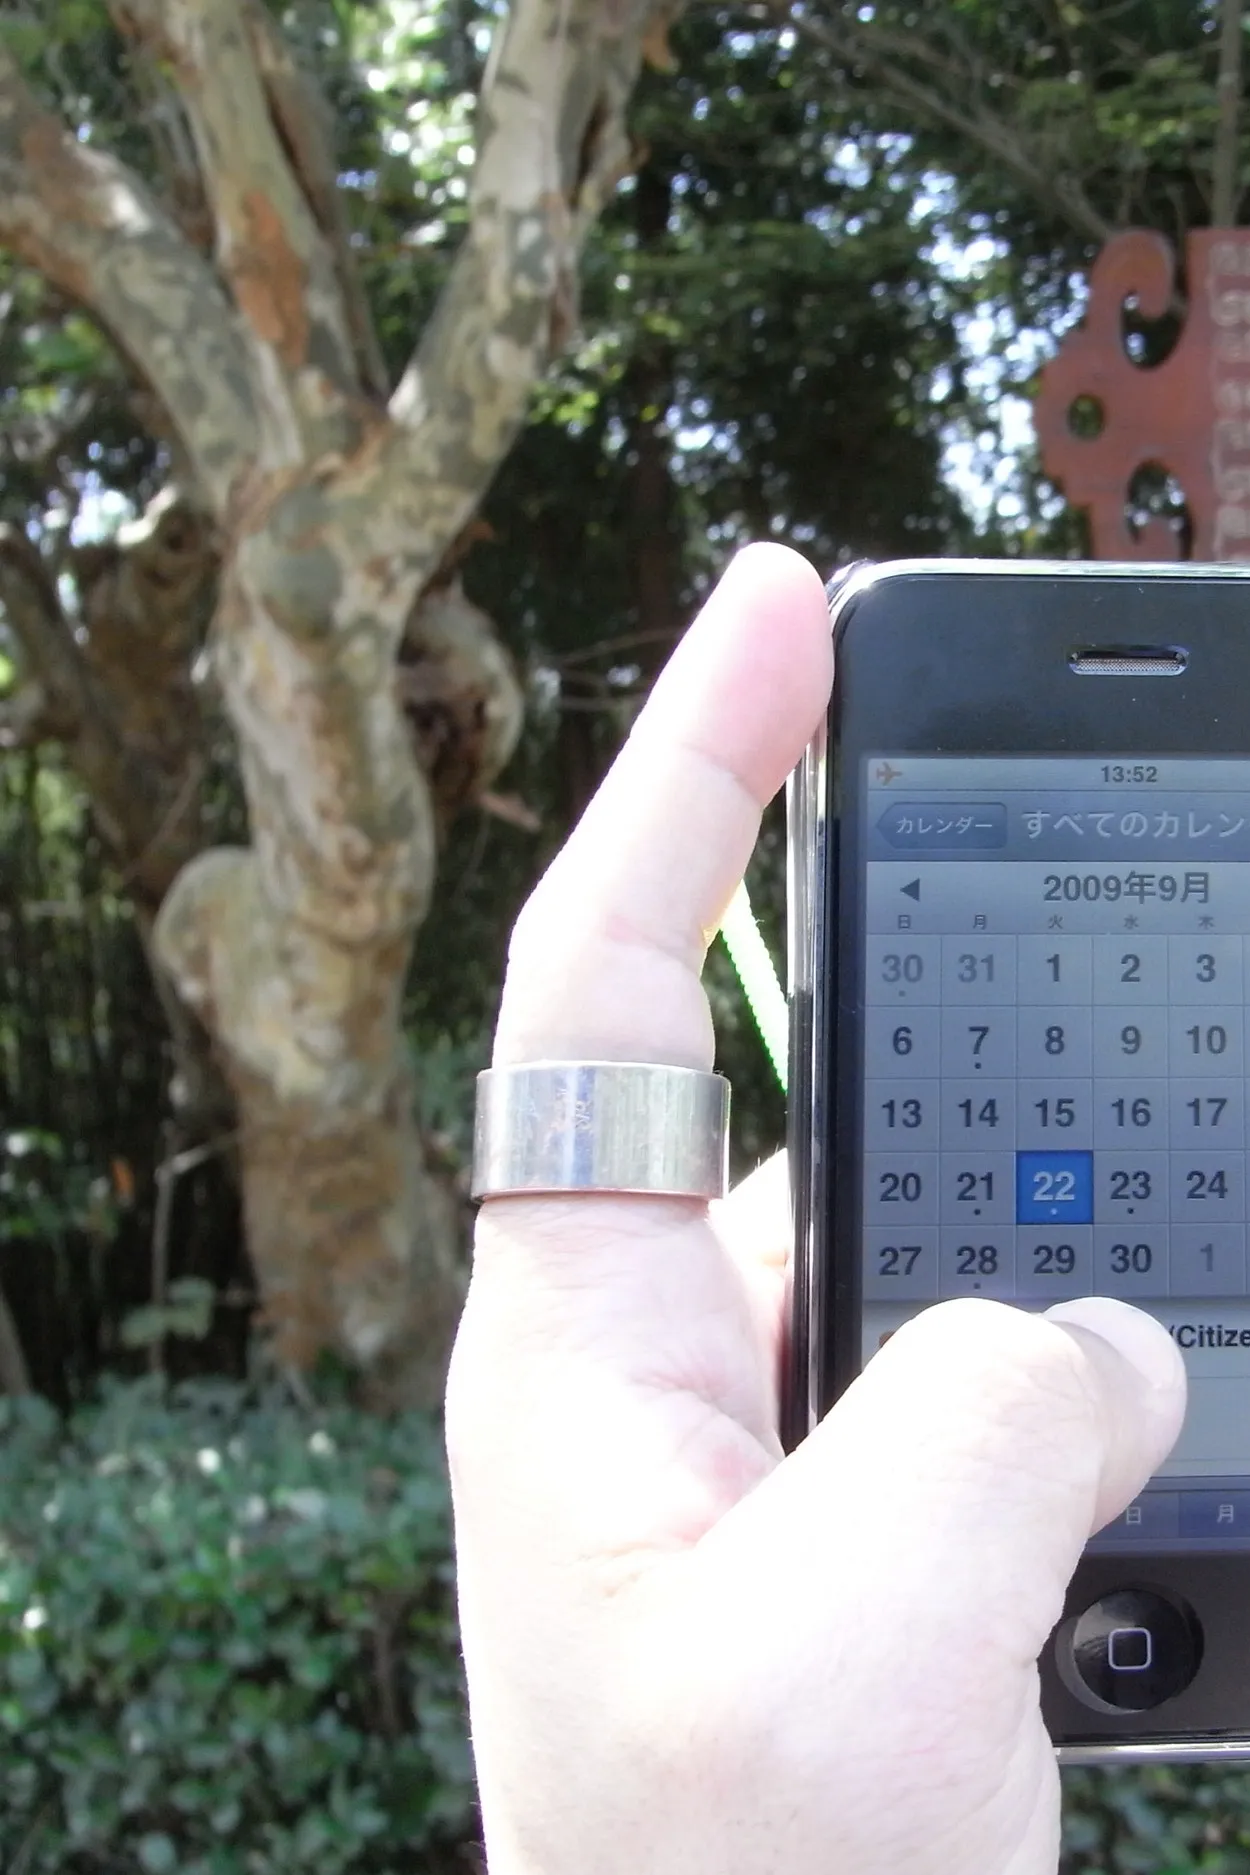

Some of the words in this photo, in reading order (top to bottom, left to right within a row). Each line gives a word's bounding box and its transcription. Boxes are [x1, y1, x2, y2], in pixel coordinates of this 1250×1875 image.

[1101, 765, 1158, 783] 13:52
[896, 815, 993, 835] カレンダー
[1043, 870, 1210, 905] 2009年9月
[898, 914, 910, 930] 日
[973, 914, 987, 931] 月
[1048, 914, 1063, 930] 火
[1124, 914, 1139, 930] 水
[1199, 914, 1215, 930] 木
[881, 953, 924, 983] 30
[957, 953, 994, 984] 31
[1046, 953, 1060, 983] 1
[1120, 953, 1141, 983] 2
[1196, 953, 1216, 983] 3
[892, 1026, 913, 1056] 6
[968, 1026, 990, 1055] 7
[1044, 1025, 1065, 1055] 8
[1120, 1025, 1142, 1055] 9
[1186, 1025, 1227, 1055] 10
[881, 1098, 922, 1129] 13
[958, 1098, 999, 1128] 14
[1034, 1098, 1075, 1128] 15
[1111, 1097, 1152, 1127] 16
[1186, 1097, 1228, 1127] 17
[879, 1172, 922, 1202] 20
[957, 1171, 993, 1201] 21
[1033, 1170, 1075, 1201] 22
[1110, 1170, 1152, 1200] 23
[1186, 1170, 1228, 1199] 24
[879, 1246, 923, 1276] 27
[956, 1245, 998, 1275] 28
[1033, 1244, 1076, 1274] 29
[1110, 1243, 1153, 1274] 30
[1199, 1242, 1214, 1272] 1
[1126, 1506, 1141, 1525] 日
[1217, 1504, 1234, 1523] 月
